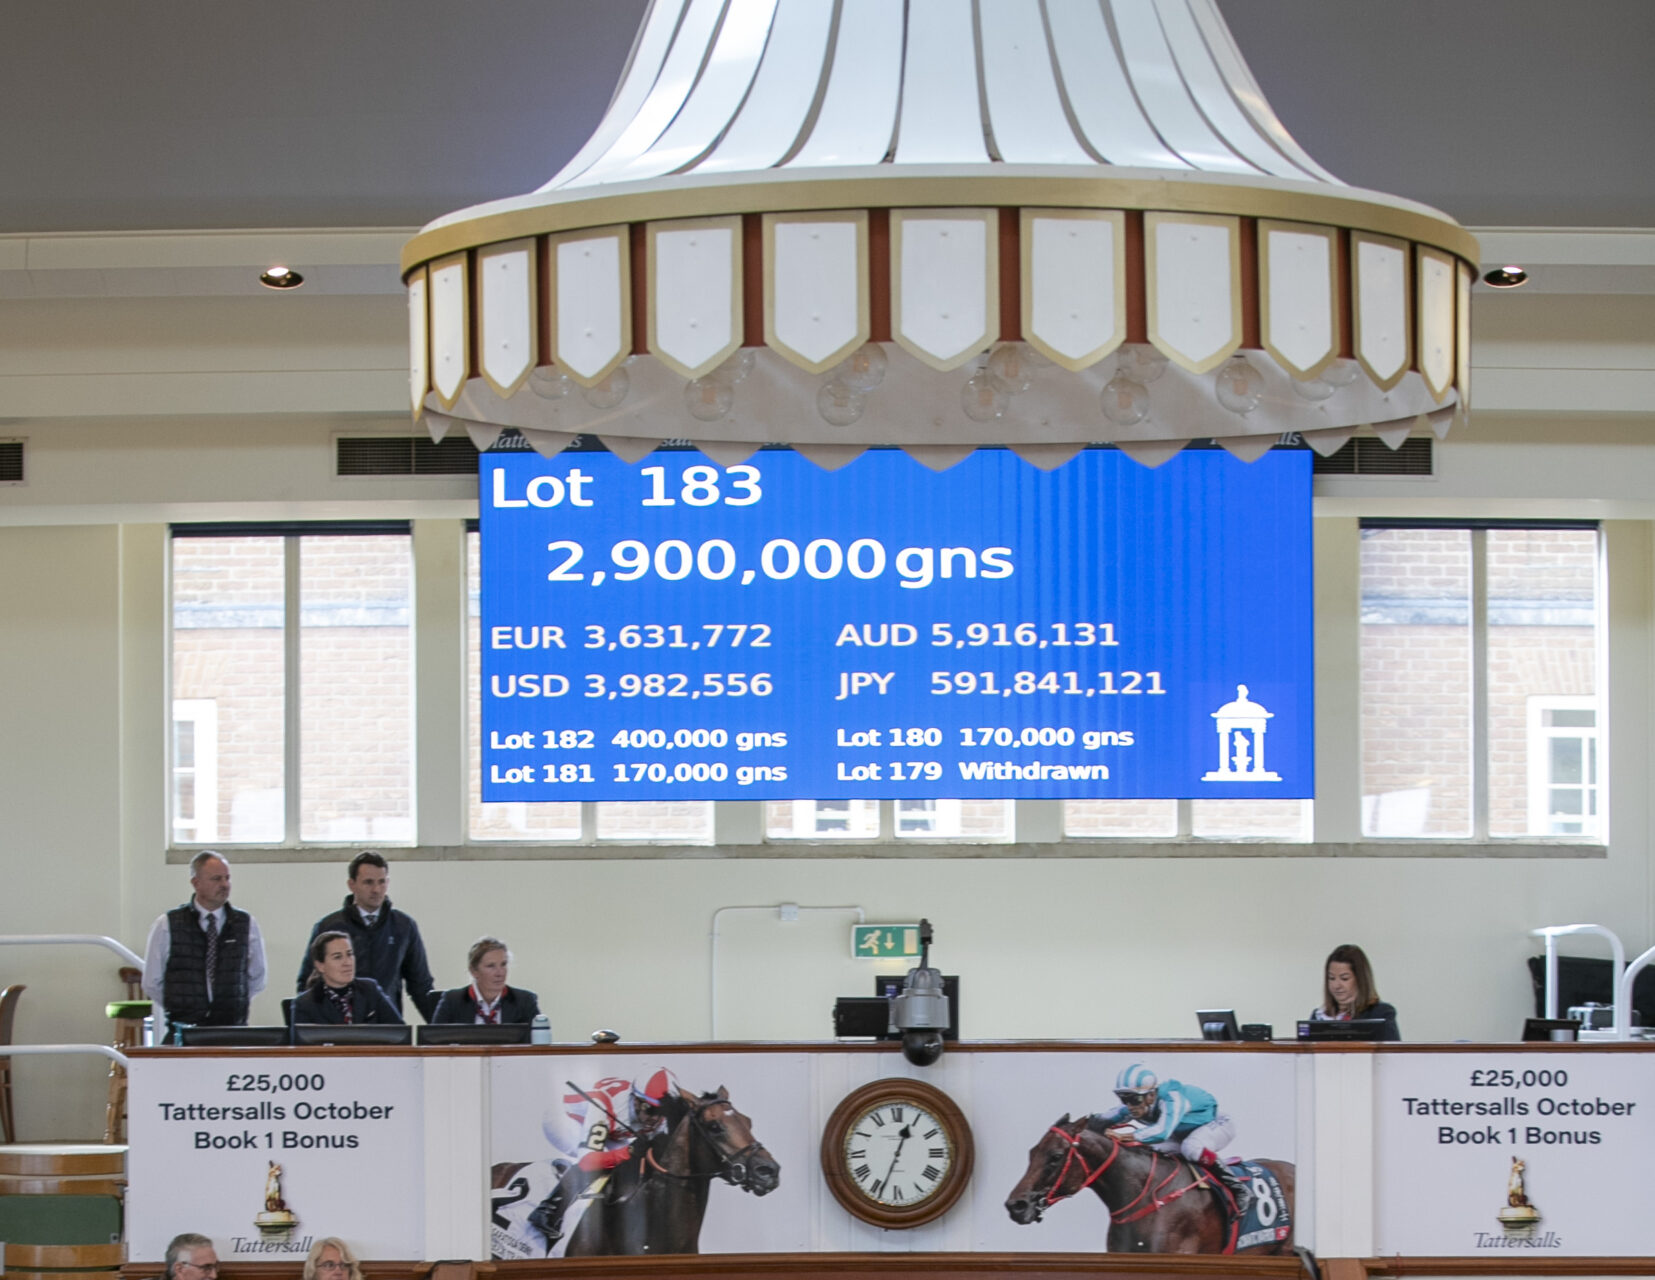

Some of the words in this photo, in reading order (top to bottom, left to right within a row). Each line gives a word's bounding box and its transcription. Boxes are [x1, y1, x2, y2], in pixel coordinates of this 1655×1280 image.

[494, 468, 593, 507] Lot
[641, 464, 761, 506] 183
[548, 539, 885, 586] 2,900,000
[896, 547, 1014, 588] gns
[492, 626, 566, 649] EUR
[584, 624, 771, 650] 3,631,772
[836, 624, 917, 646] AUD
[932, 623, 1119, 648] 5,916,131
[492, 675, 569, 697] USD
[585, 673, 772, 700] 3,982,556
[836, 672, 894, 700] JPY
[931, 671, 1166, 697] 591,841,121
[491, 731, 535, 749] Lot
[543, 730, 594, 748] 182
[612, 729, 728, 749] 400,000
[736, 732, 787, 751] gns
[837, 729, 881, 746] Lot
[889, 728, 942, 746] 180
[960, 728, 1075, 747] 170,000
[1083, 731, 1134, 750] gns
[491, 765, 535, 783] Lot
[543, 764, 594, 782] 181
[614, 763, 728, 783] 170,000
[736, 767, 787, 785] gns
[838, 763, 881, 780] Lot
[890, 762, 942, 780] 179
[959, 761, 1109, 780] Withdrawn
[227, 1074, 324, 1093] £25,000
[1471, 1070, 1567, 1089] £25,000
[159, 1102, 285, 1120] Tattersalls
[294, 1101, 393, 1120] October
[1402, 1097, 1529, 1115] Tattersalls
[1537, 1098, 1635, 1115] October
[195, 1131, 257, 1149] Book
[265, 1132, 272, 1148] 1
[283, 1131, 359, 1148] Bonus
[587, 1125, 607, 1150] 2
[1439, 1126, 1501, 1144] Book
[1509, 1128, 1515, 1144] 1
[1526, 1127, 1601, 1144] Bonus
[1252, 1177, 1278, 1227] 8
[231, 1235, 313, 1254] Tattersall
[1474, 1231, 1562, 1249] Tattersalls
